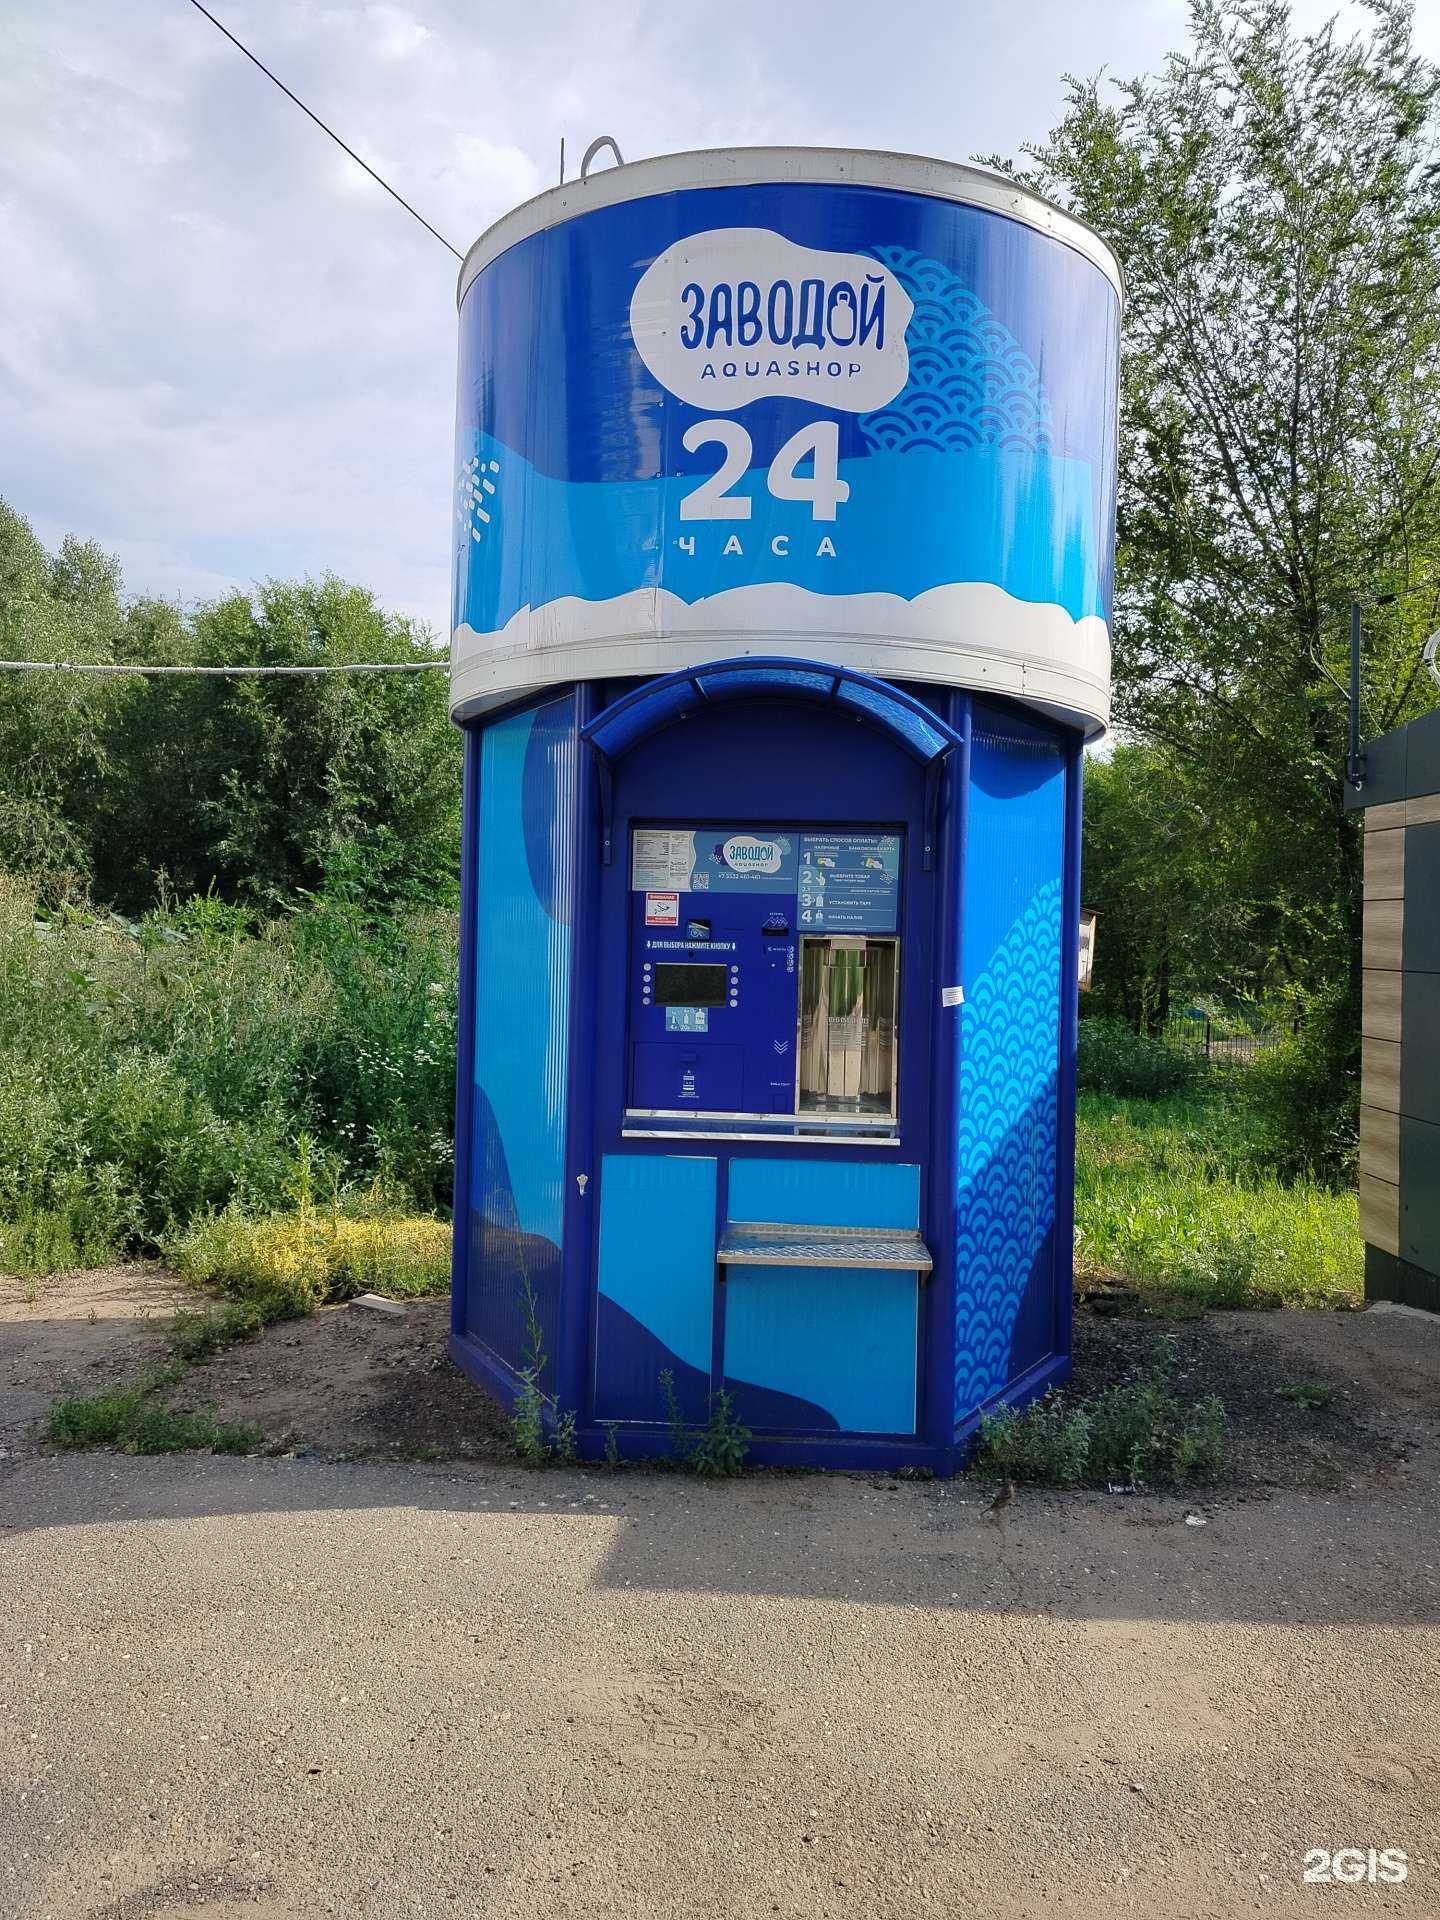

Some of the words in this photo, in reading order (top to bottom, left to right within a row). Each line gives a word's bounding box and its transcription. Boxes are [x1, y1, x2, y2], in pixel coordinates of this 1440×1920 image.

[680, 273, 885, 350] ЗАВОДОЙ
[701, 360, 861, 380] AQUASHOP
[680, 419, 850, 521] 24
[679, 535, 837, 557] ЧАСА
[729, 845, 774, 861] ЗАВОДОЙ
[803, 851, 811, 865] 1
[802, 870, 812, 884] 2
[802, 893, 812, 907] 3
[801, 909, 813, 923] 4
[651, 941, 664, 949] ДЛЯ
[664, 941, 684, 949] ВЫБОРА
[685, 942, 709, 950] НАЖМИТЕ
